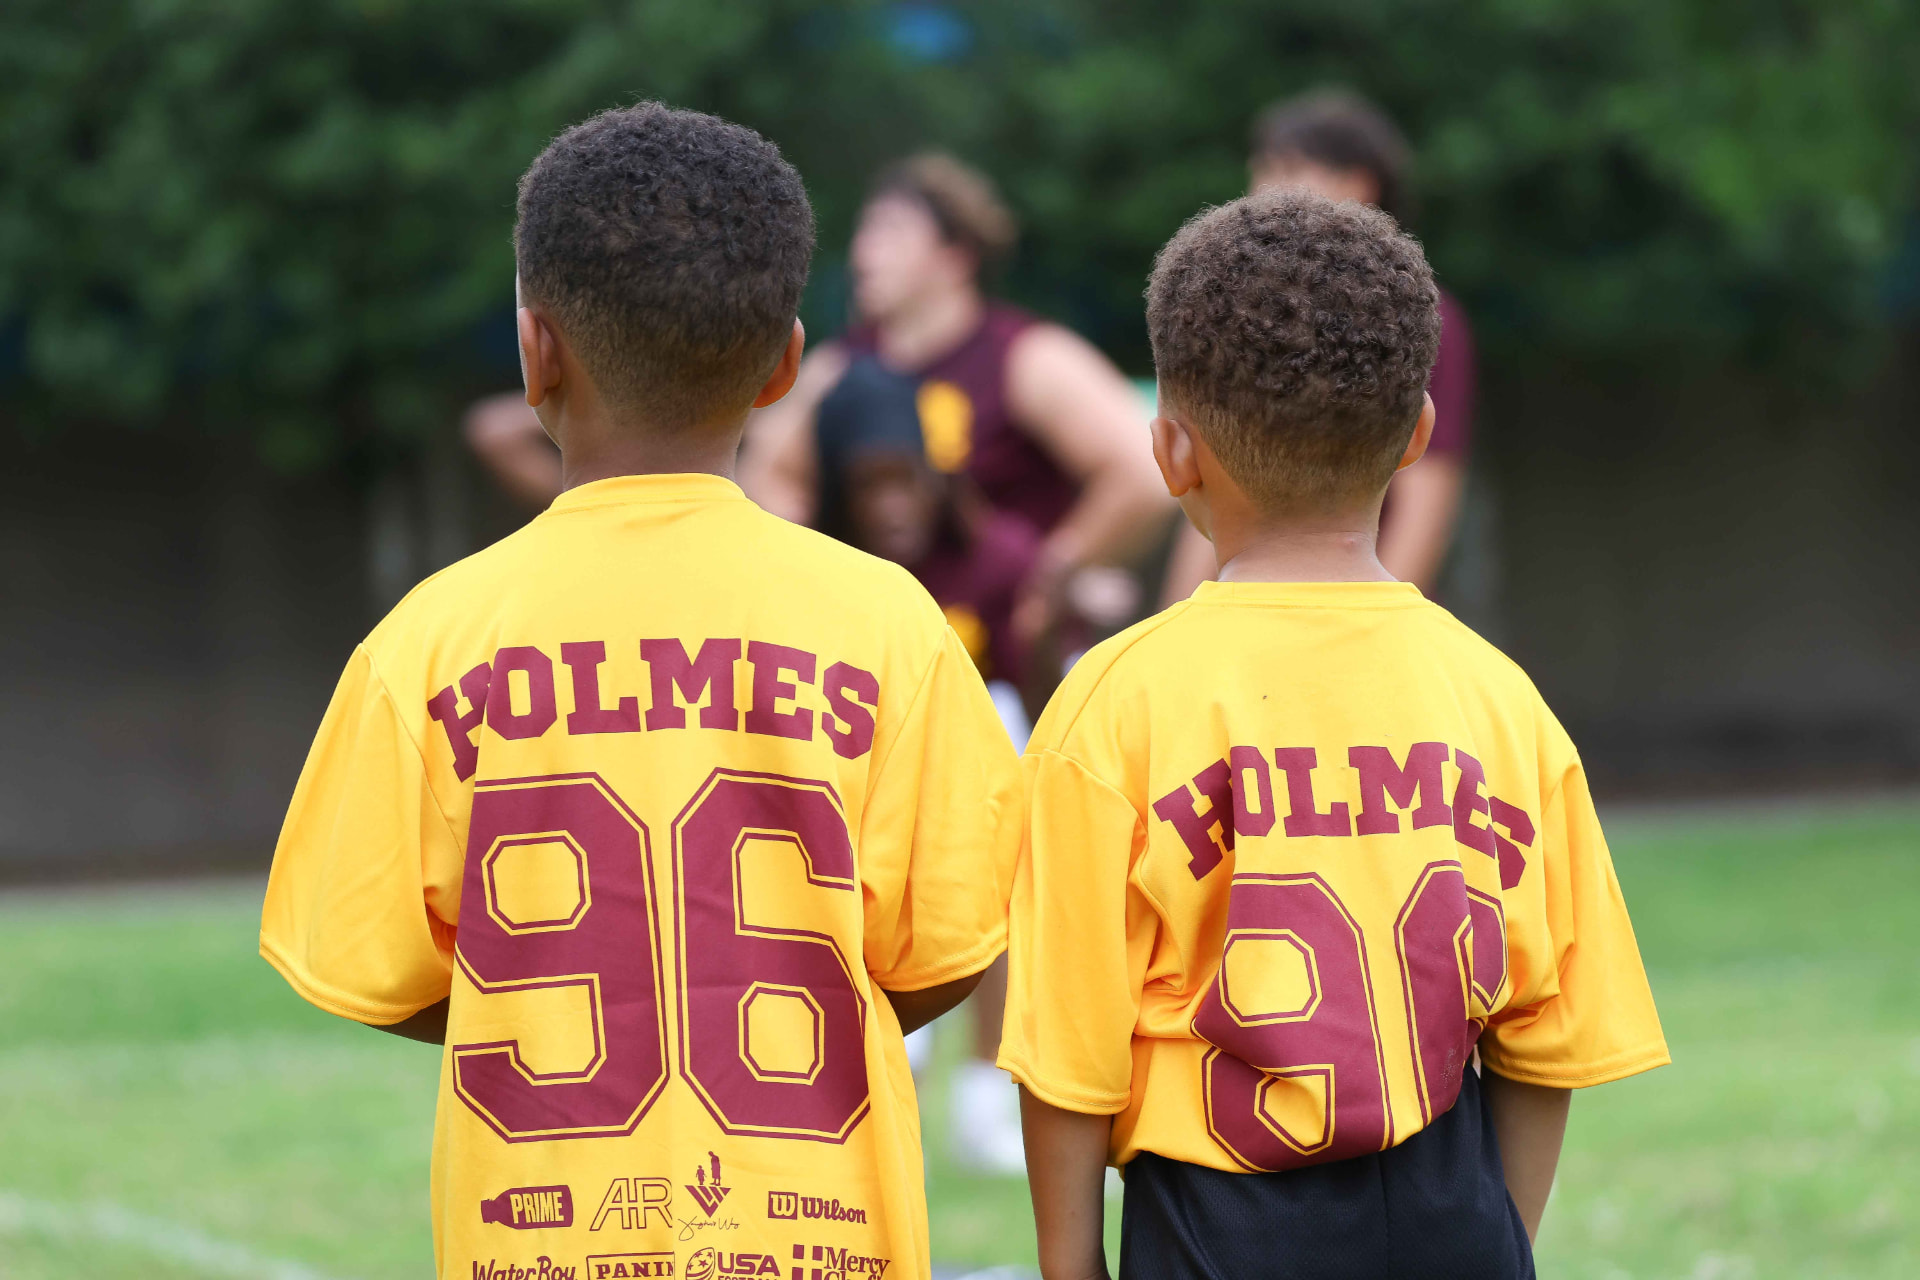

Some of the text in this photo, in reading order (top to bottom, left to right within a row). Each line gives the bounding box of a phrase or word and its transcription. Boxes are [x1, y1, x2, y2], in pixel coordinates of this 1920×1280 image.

[427, 638, 880, 782] HOLMES
[1152, 741, 1535, 891] HOLMES
[453, 767, 871, 1144] 96
[510, 1191, 564, 1224] PRIME
[801, 1197, 867, 1224] Wilson
[595, 1261, 674, 1279] PANIN
[717, 1252, 780, 1276] USA
[824, 1246, 891, 1277] Mercy
